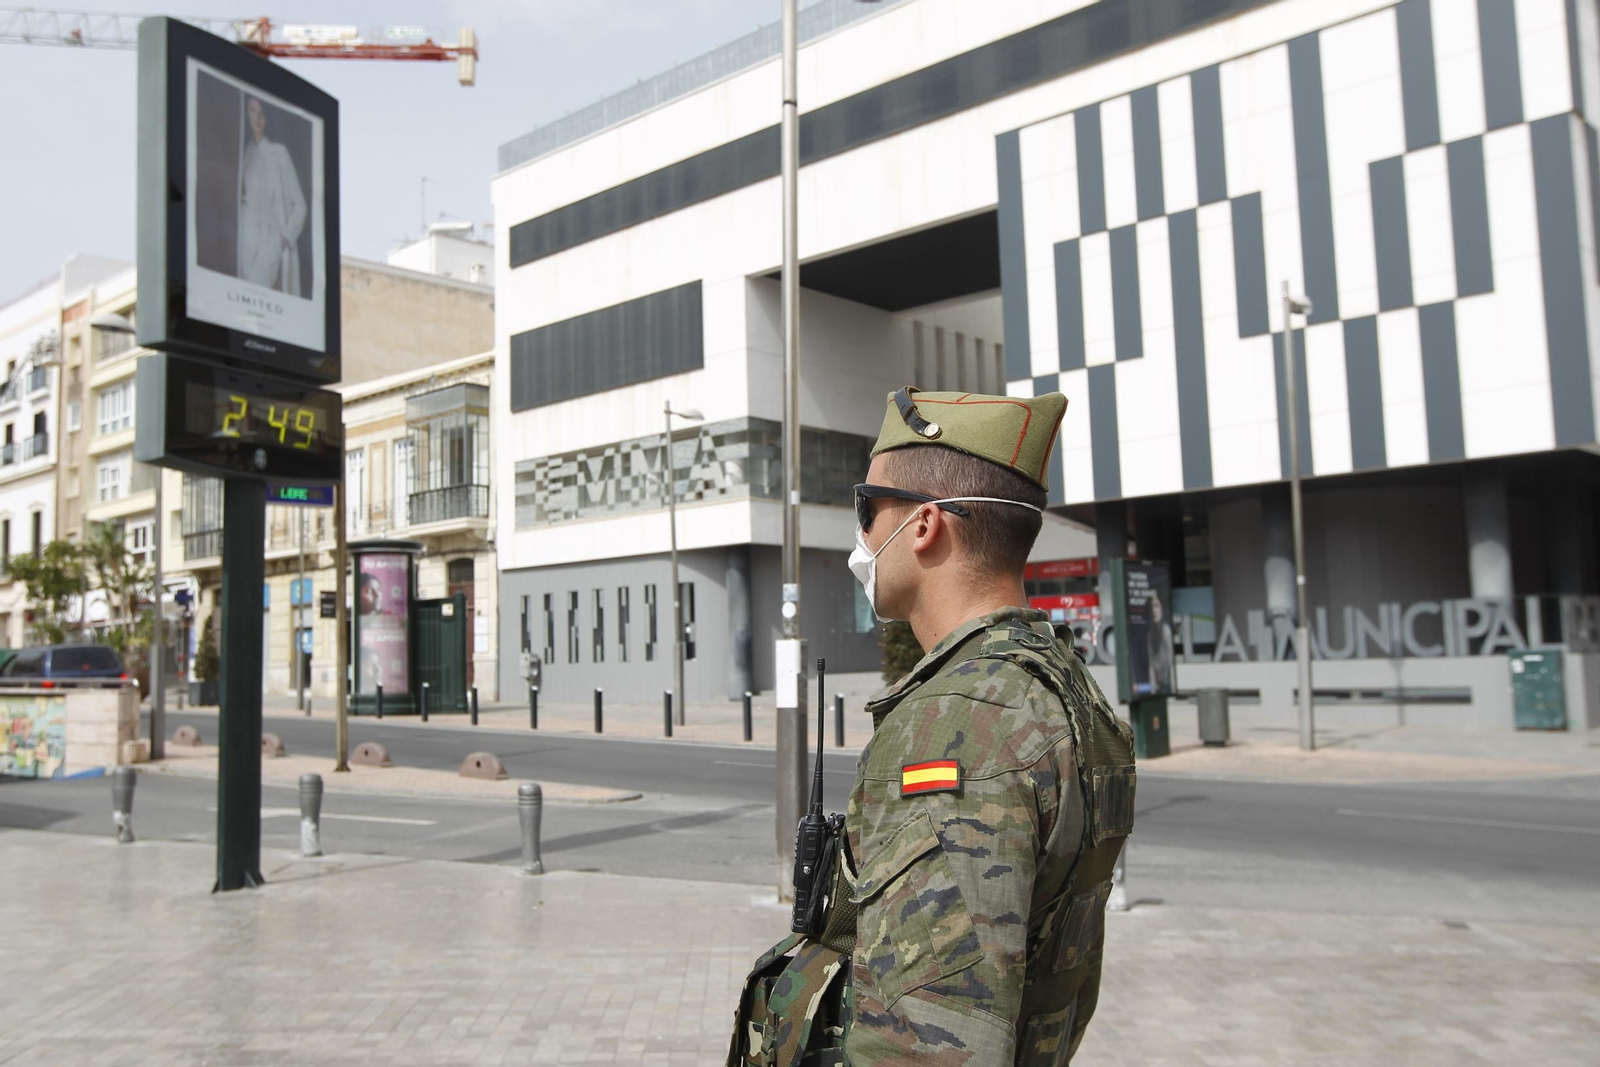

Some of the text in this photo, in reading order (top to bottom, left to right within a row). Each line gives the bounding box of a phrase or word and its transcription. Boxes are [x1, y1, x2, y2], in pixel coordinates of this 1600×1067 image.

[227, 291, 284, 316] LIMITED
[268, 405, 314, 449] 49
[534, 429, 727, 524] EMMA
[1276, 595, 1569, 661] MUNICIPAL
